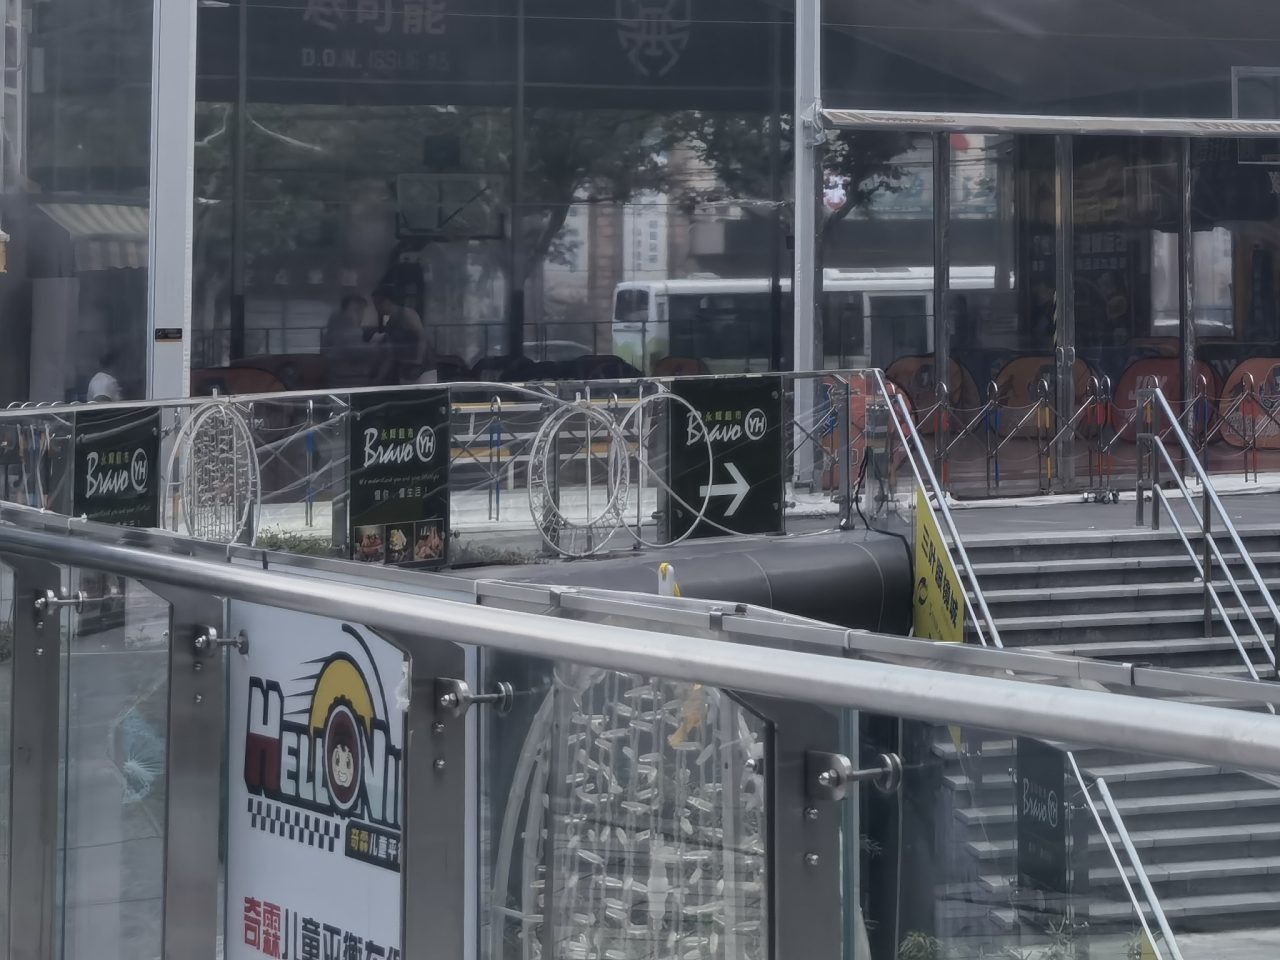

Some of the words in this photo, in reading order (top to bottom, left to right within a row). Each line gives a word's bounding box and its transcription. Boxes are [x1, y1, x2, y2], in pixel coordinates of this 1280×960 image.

[363, 427, 415, 469] Bravo
[686, 410, 743, 446] Bravo
[86, 451, 130, 499] Bravo
[245, 676, 401, 831] HELLONI
[351, 827, 401, 865] 奇霖儿童平
[244, 896, 400, 960] 奇霖儿童平衡
